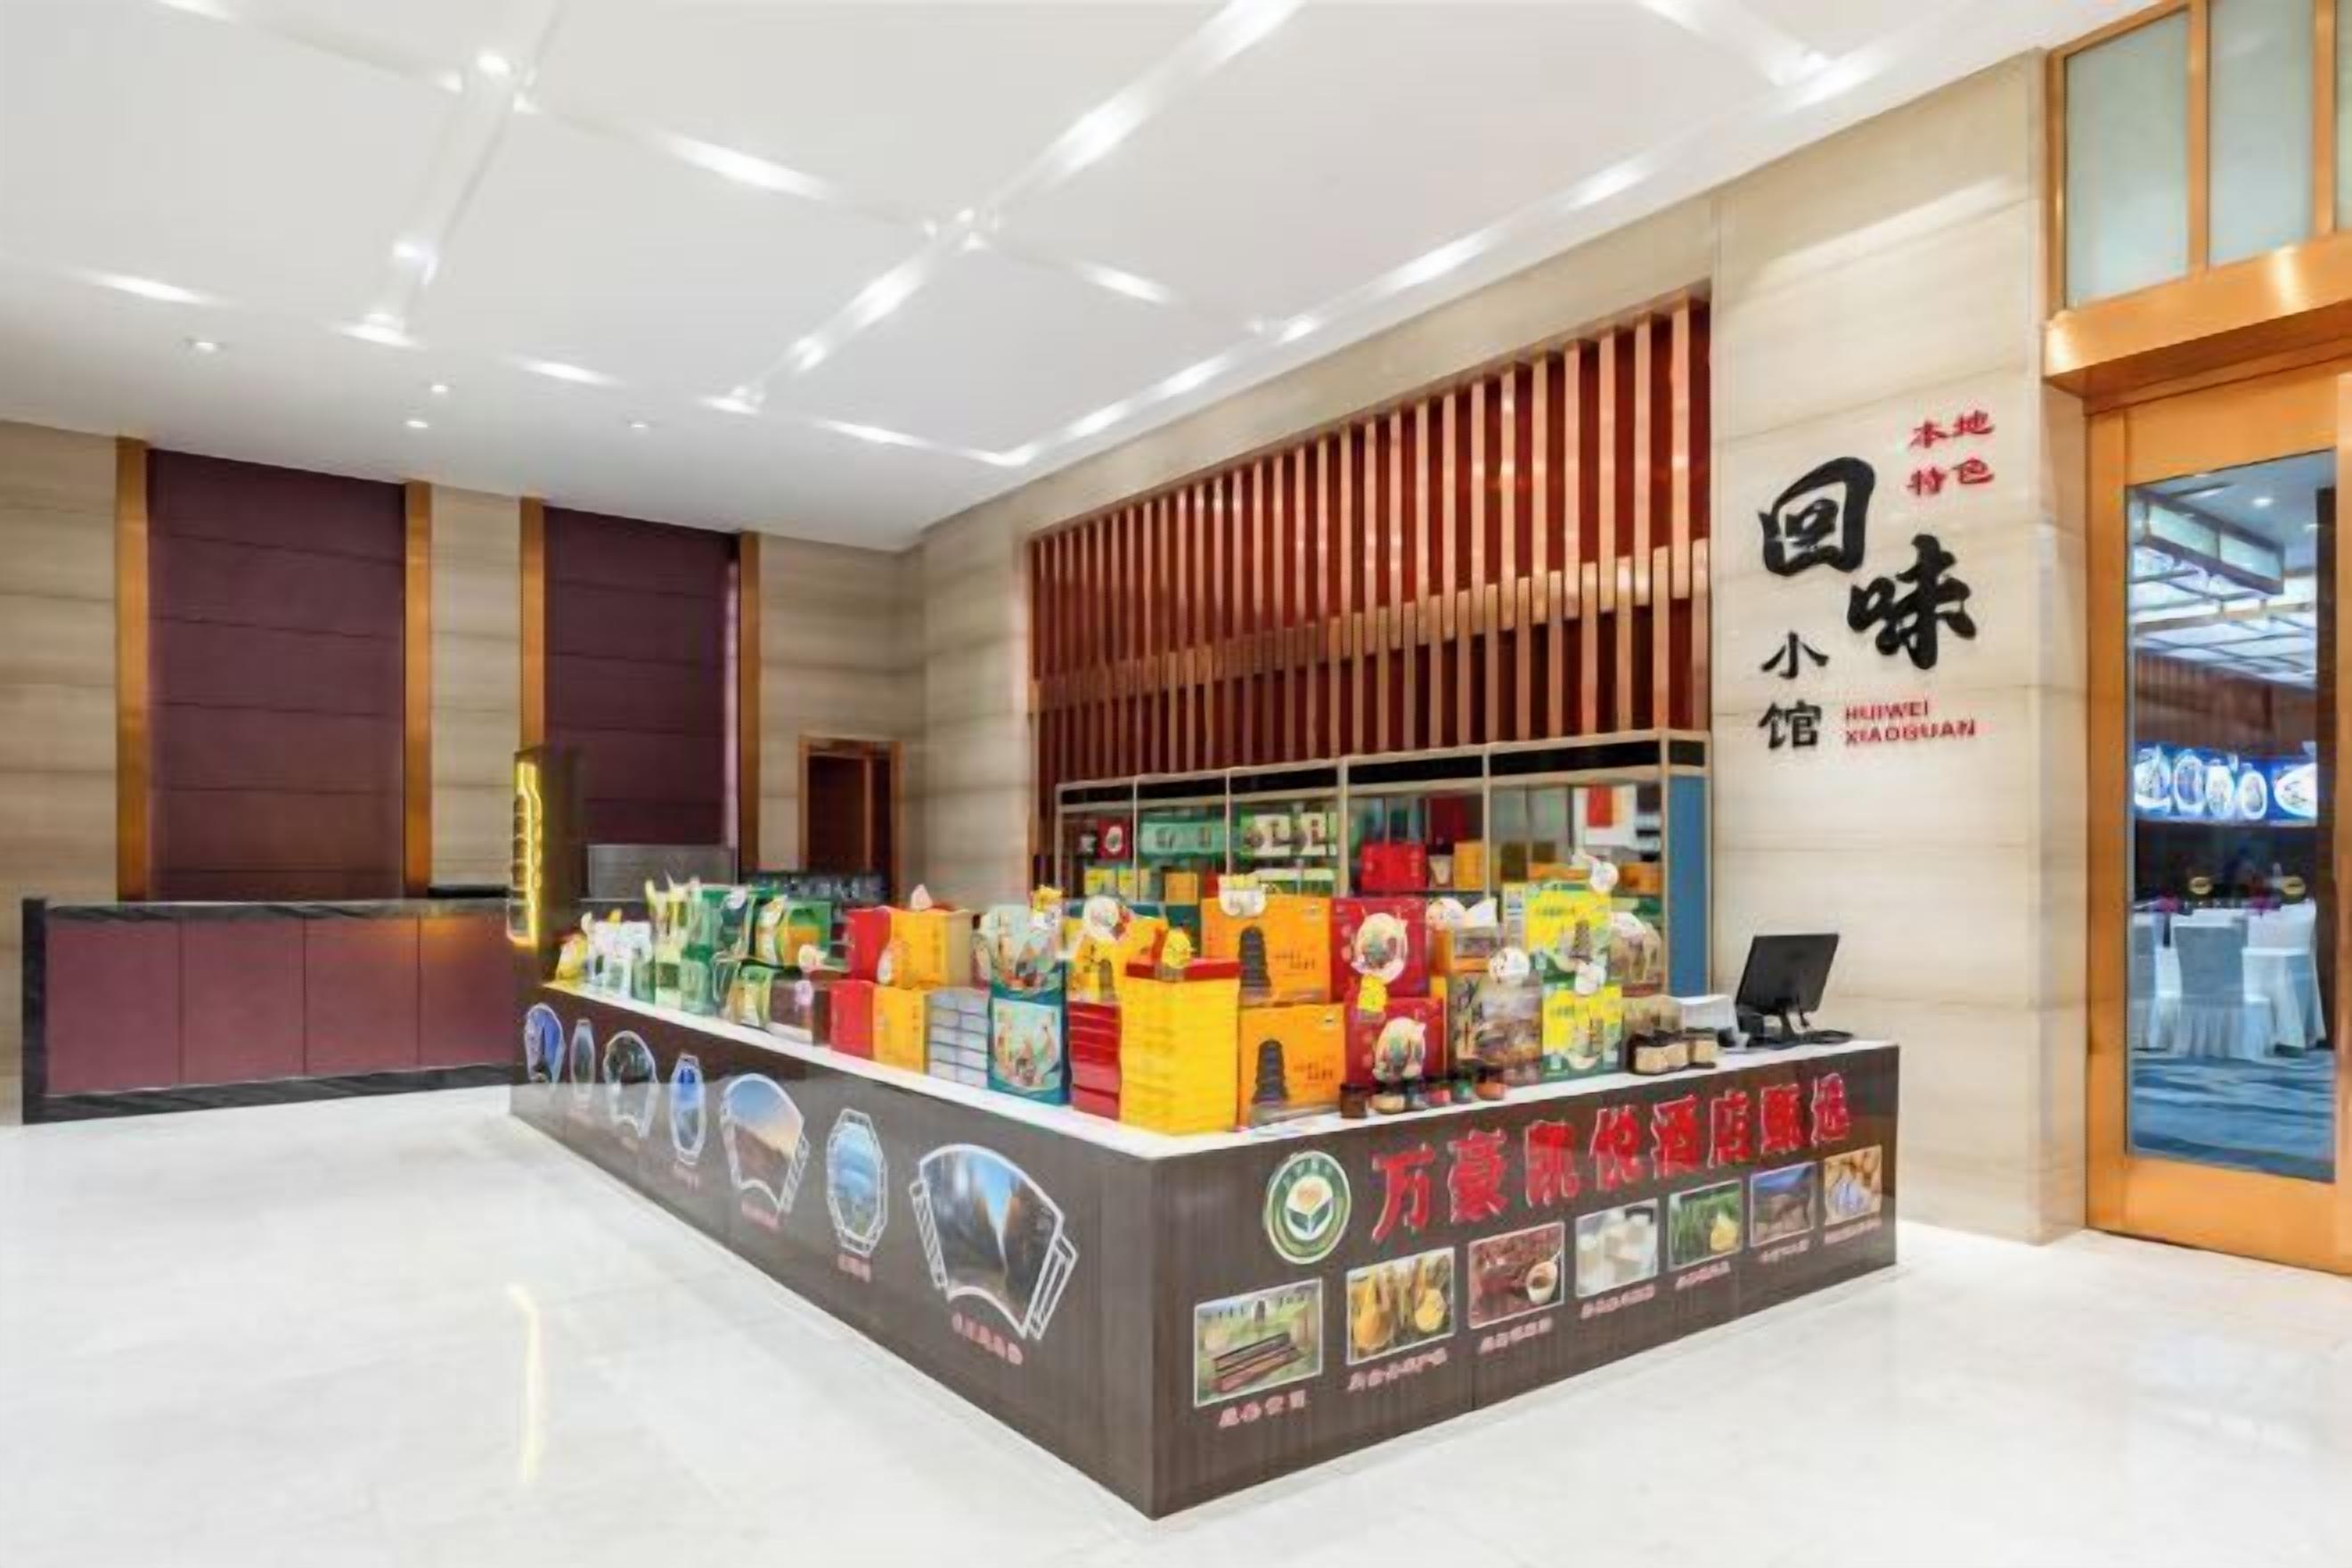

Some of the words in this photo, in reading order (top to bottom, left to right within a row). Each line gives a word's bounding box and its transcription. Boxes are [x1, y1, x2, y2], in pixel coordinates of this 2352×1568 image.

[1909, 409, 1995, 450] 本地
[1907, 456, 1995, 495] 特色
[1758, 456, 1977, 670] 回味
[1758, 631, 1830, 750] 小馆
[1846, 699, 1929, 721] HUIWEI
[1845, 718, 1975, 747] XIAOGUAN
